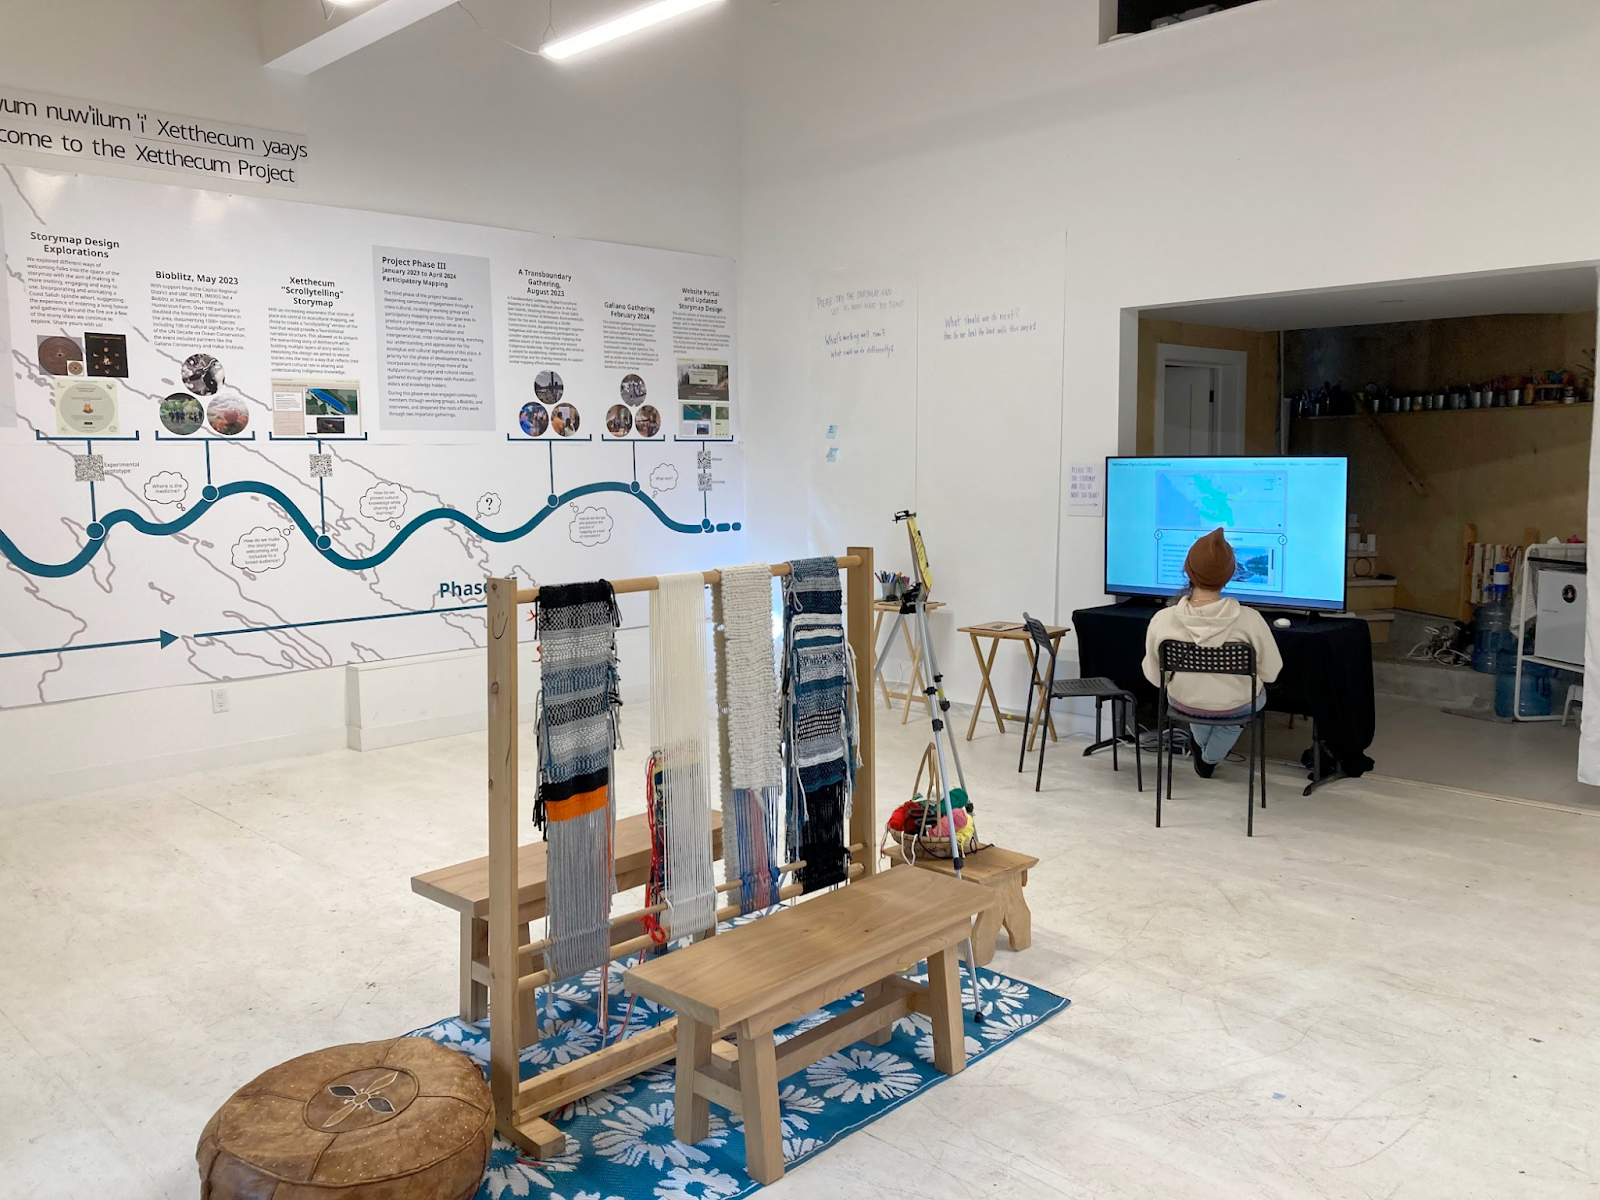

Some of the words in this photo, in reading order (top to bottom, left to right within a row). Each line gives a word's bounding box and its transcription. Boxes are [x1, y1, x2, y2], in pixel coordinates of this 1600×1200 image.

[157, 118, 254, 150] Xetthecum
[262, 138, 308, 160] yaays
[61, 134, 83, 152] to
[92, 138, 125, 158] the
[136, 143, 230, 174] Xetthecum
[239, 159, 295, 183] Project
[30, 231, 82, 246] Storymap
[84, 237, 120, 250] Design
[43, 244, 109, 258] Explorations
[27, 263, 56, 271] welcoming
[382, 256, 411, 267] Project
[412, 259, 436, 269] Phase
[437, 262, 447, 270] III
[92, 275, 111, 283] making
[155, 270, 194, 282] Bioblitz,
[197, 274, 217, 285] May
[218, 276, 239, 285] 2023
[381, 267, 406, 275] January
[428, 271, 443, 279] April
[444, 272, 457, 280] 2024
[524, 269, 572, 282] Transboundary
[289, 276, 335, 288] Xetthecum
[382, 275, 422, 286] Participatory
[422, 279, 449, 288] Mapping
[527, 278, 561, 289] Gathering,
[526, 287, 550, 296] August
[550, 289, 565, 297] 2023
[681, 287, 702, 295] Website
[703, 289, 720, 297] Portal
[293, 297, 334, 308] Storymap
[604, 301, 626, 310] Galiano
[627, 304, 655, 314] Gathering
[678, 303, 705, 312] Storymap
[705, 305, 723, 314] Design
[610, 310, 636, 320] February
[945, 315, 961, 328] What
[964, 313, 980, 324] should
[991, 312, 997, 321] do
[999, 307, 1020, 320] next?
[485, 497, 493, 510] ?
